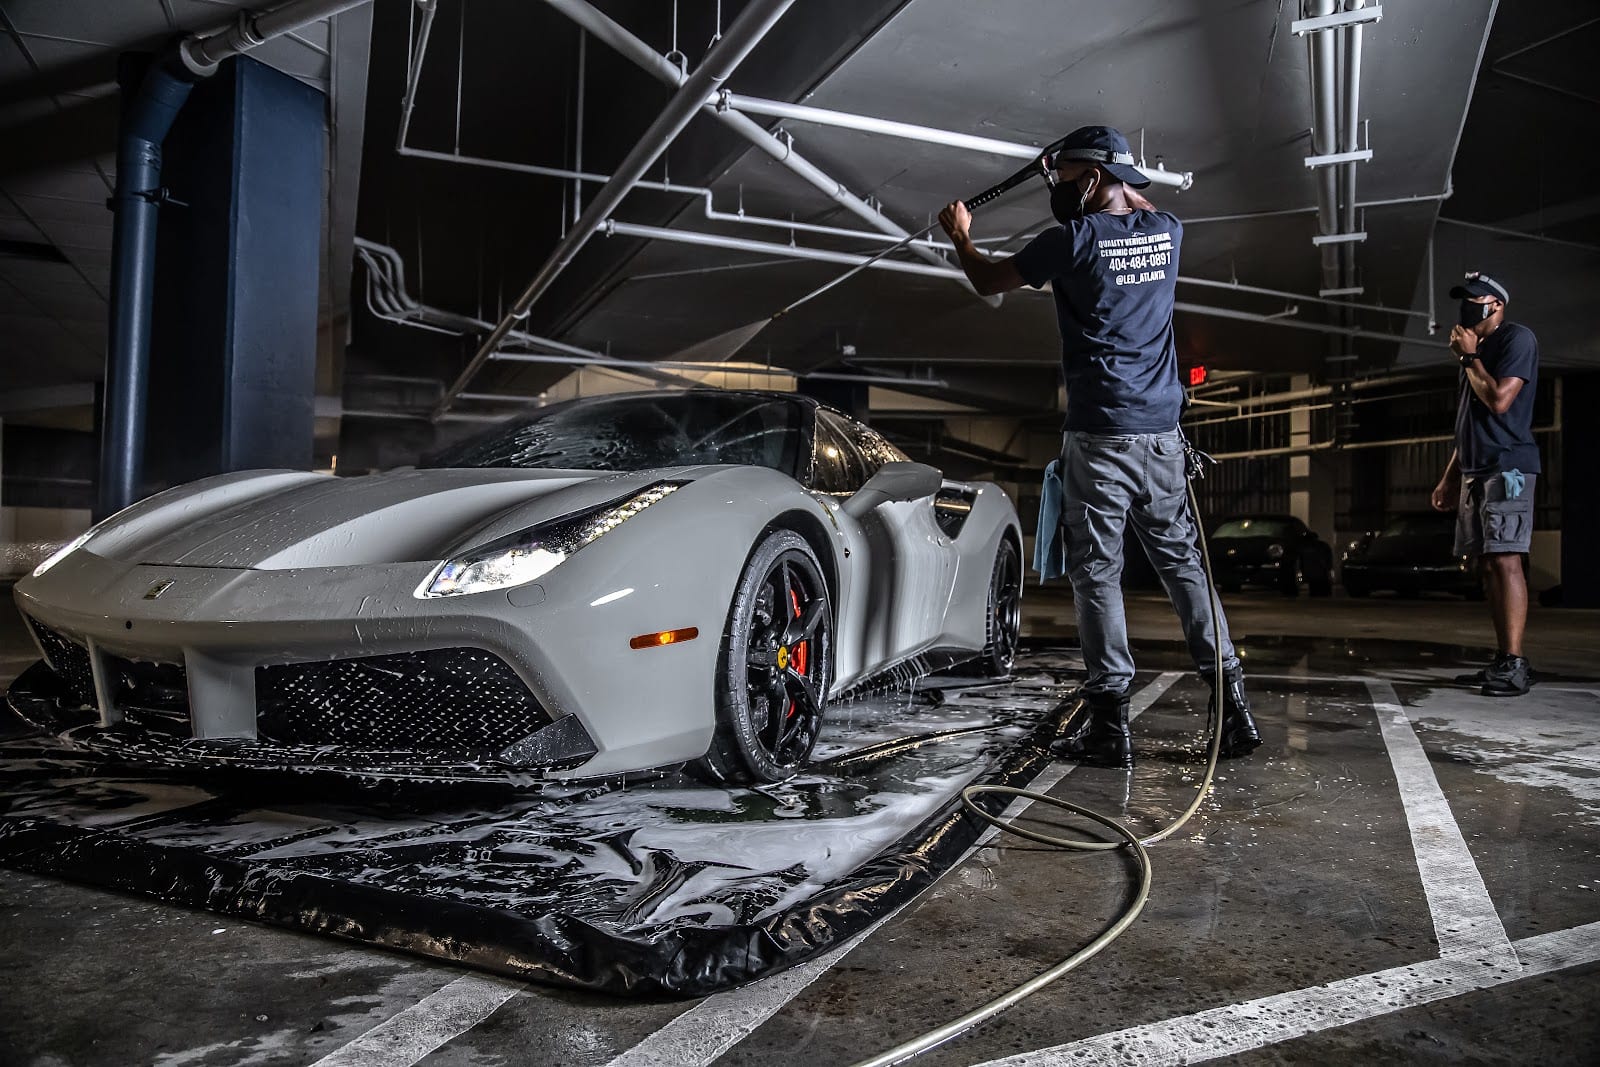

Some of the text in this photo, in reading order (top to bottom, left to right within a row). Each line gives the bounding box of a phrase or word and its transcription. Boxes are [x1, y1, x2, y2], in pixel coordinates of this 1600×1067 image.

[1098, 238, 1124, 249] QUALITY
[1125, 236, 1147, 247] VEHICLE
[1100, 246, 1128, 258] CERAMIC
[1108, 251, 1171, 271] 404-484-0891
